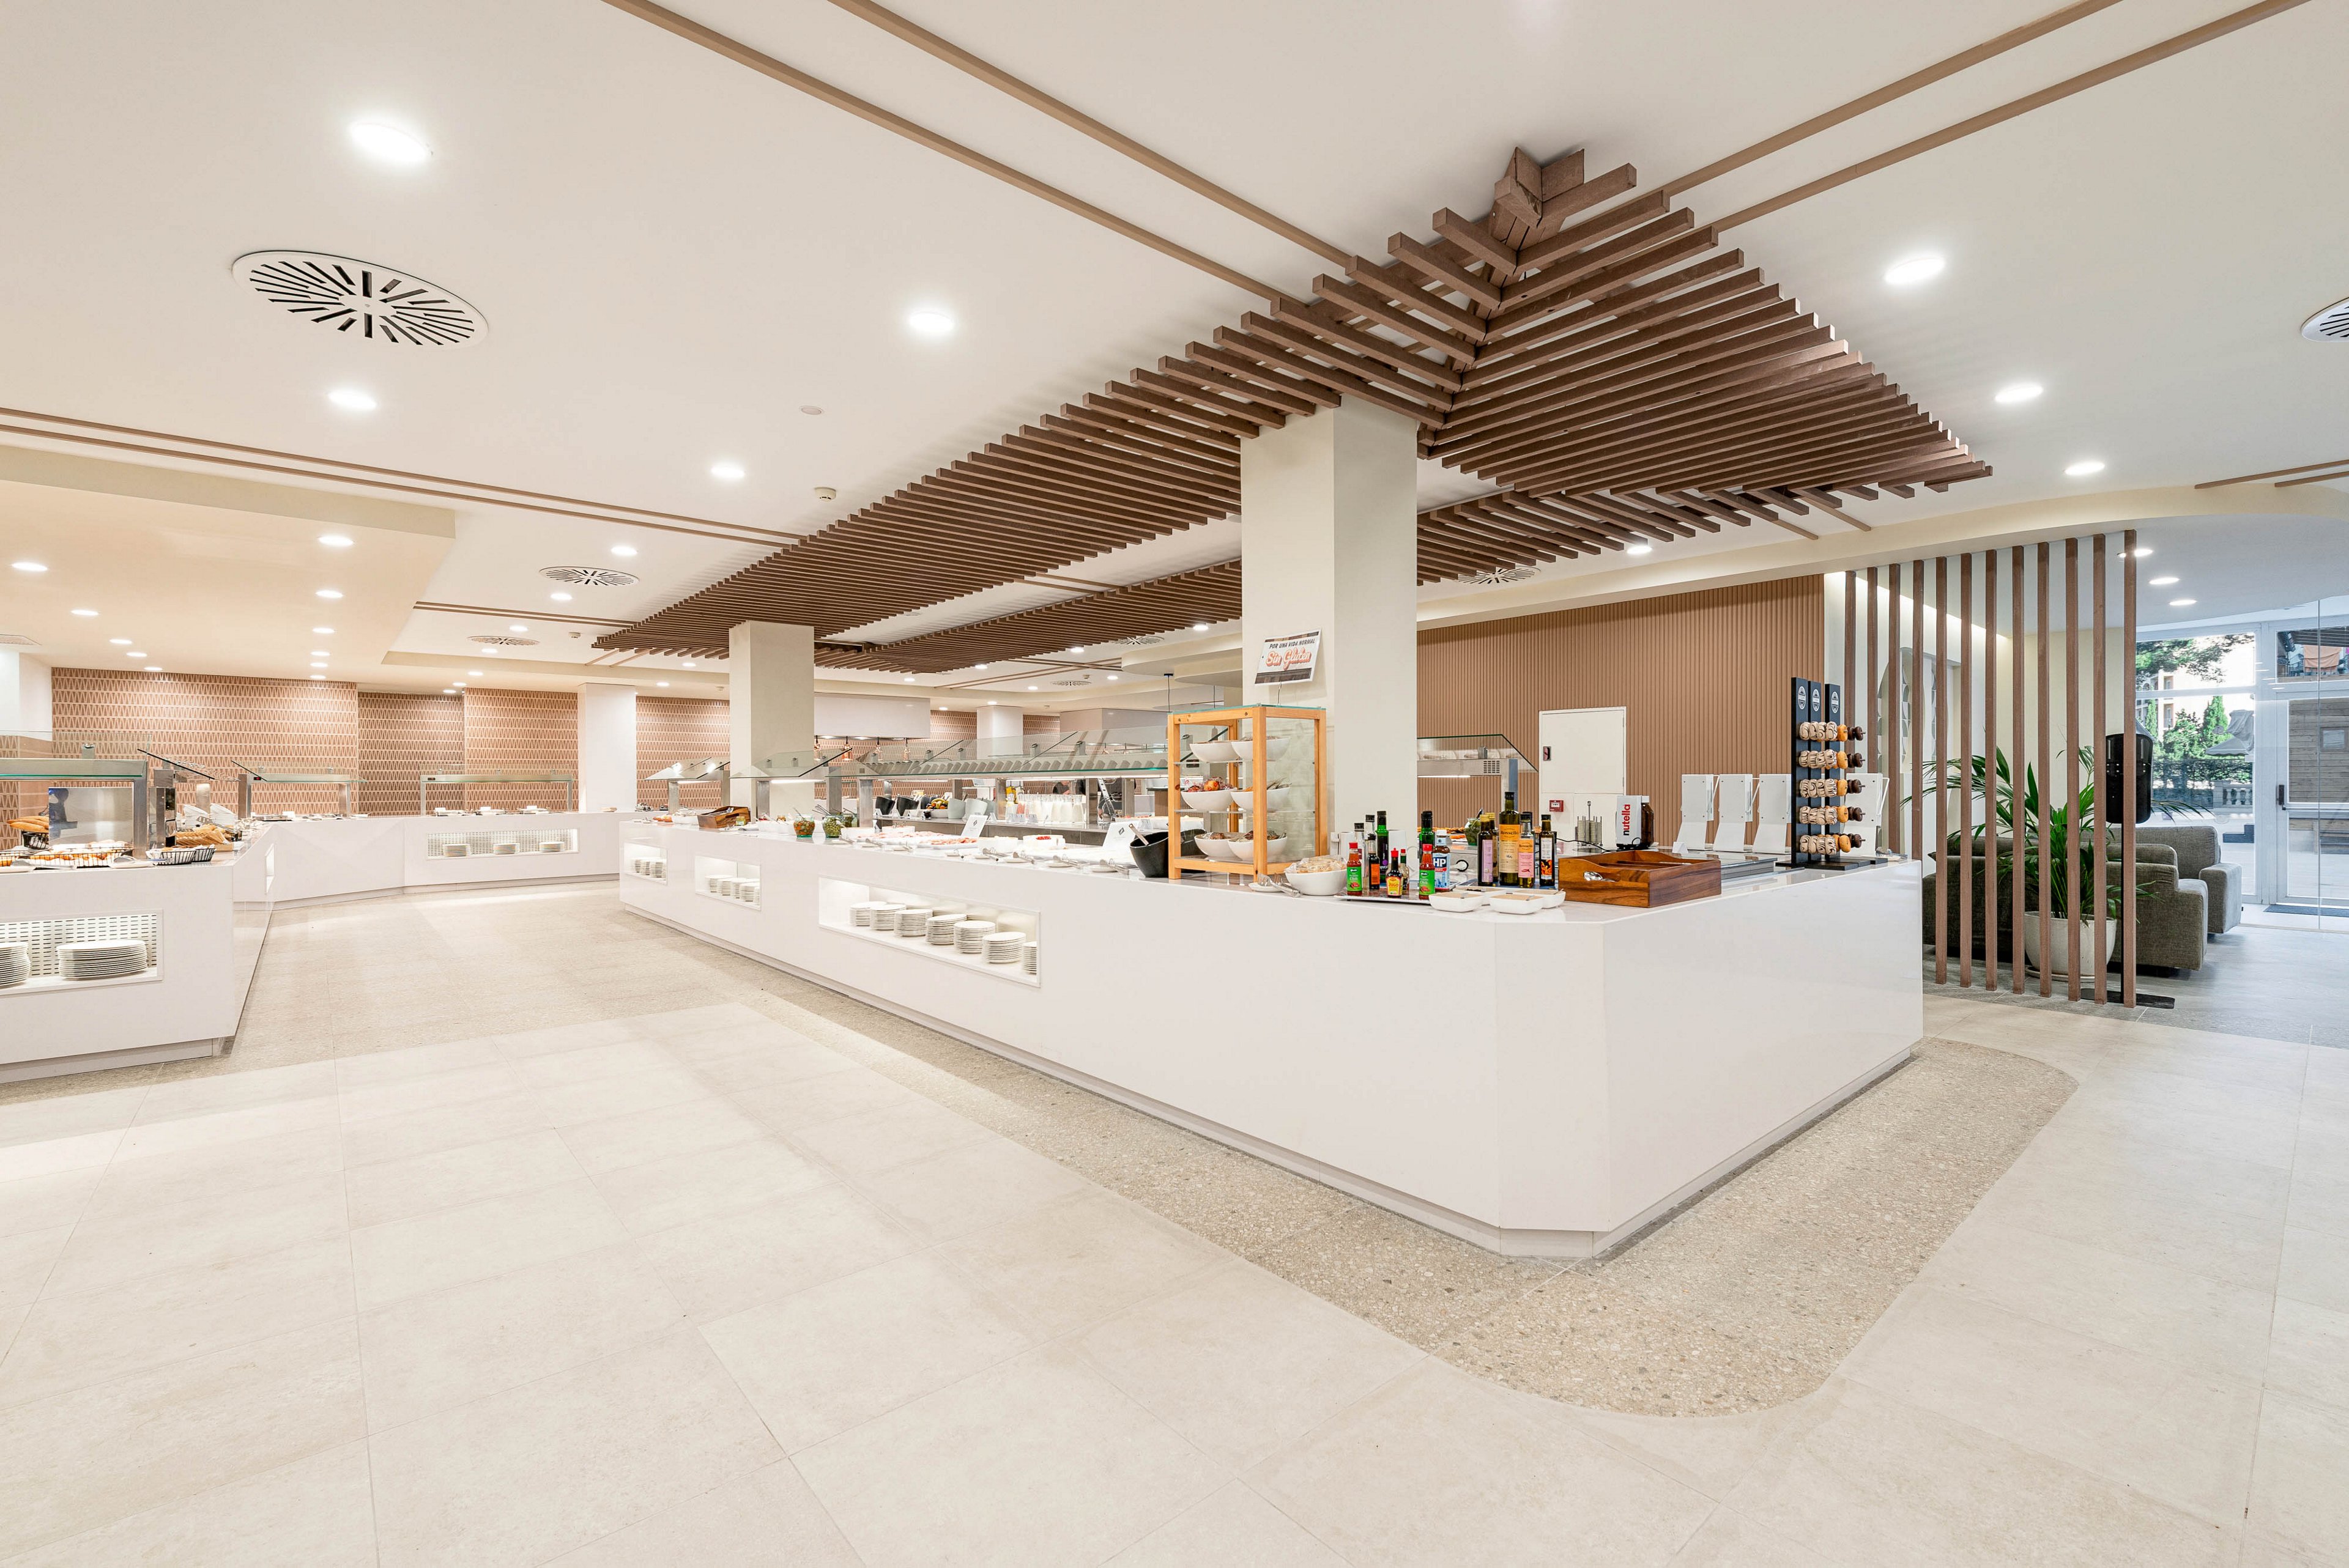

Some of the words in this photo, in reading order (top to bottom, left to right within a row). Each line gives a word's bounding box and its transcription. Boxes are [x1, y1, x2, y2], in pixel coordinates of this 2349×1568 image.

[1266, 651, 1282, 666] Sin
[1283, 647, 1312, 670] Gluten
[1622, 804, 1630, 835] nutella
[1433, 858, 1446, 867] HP
